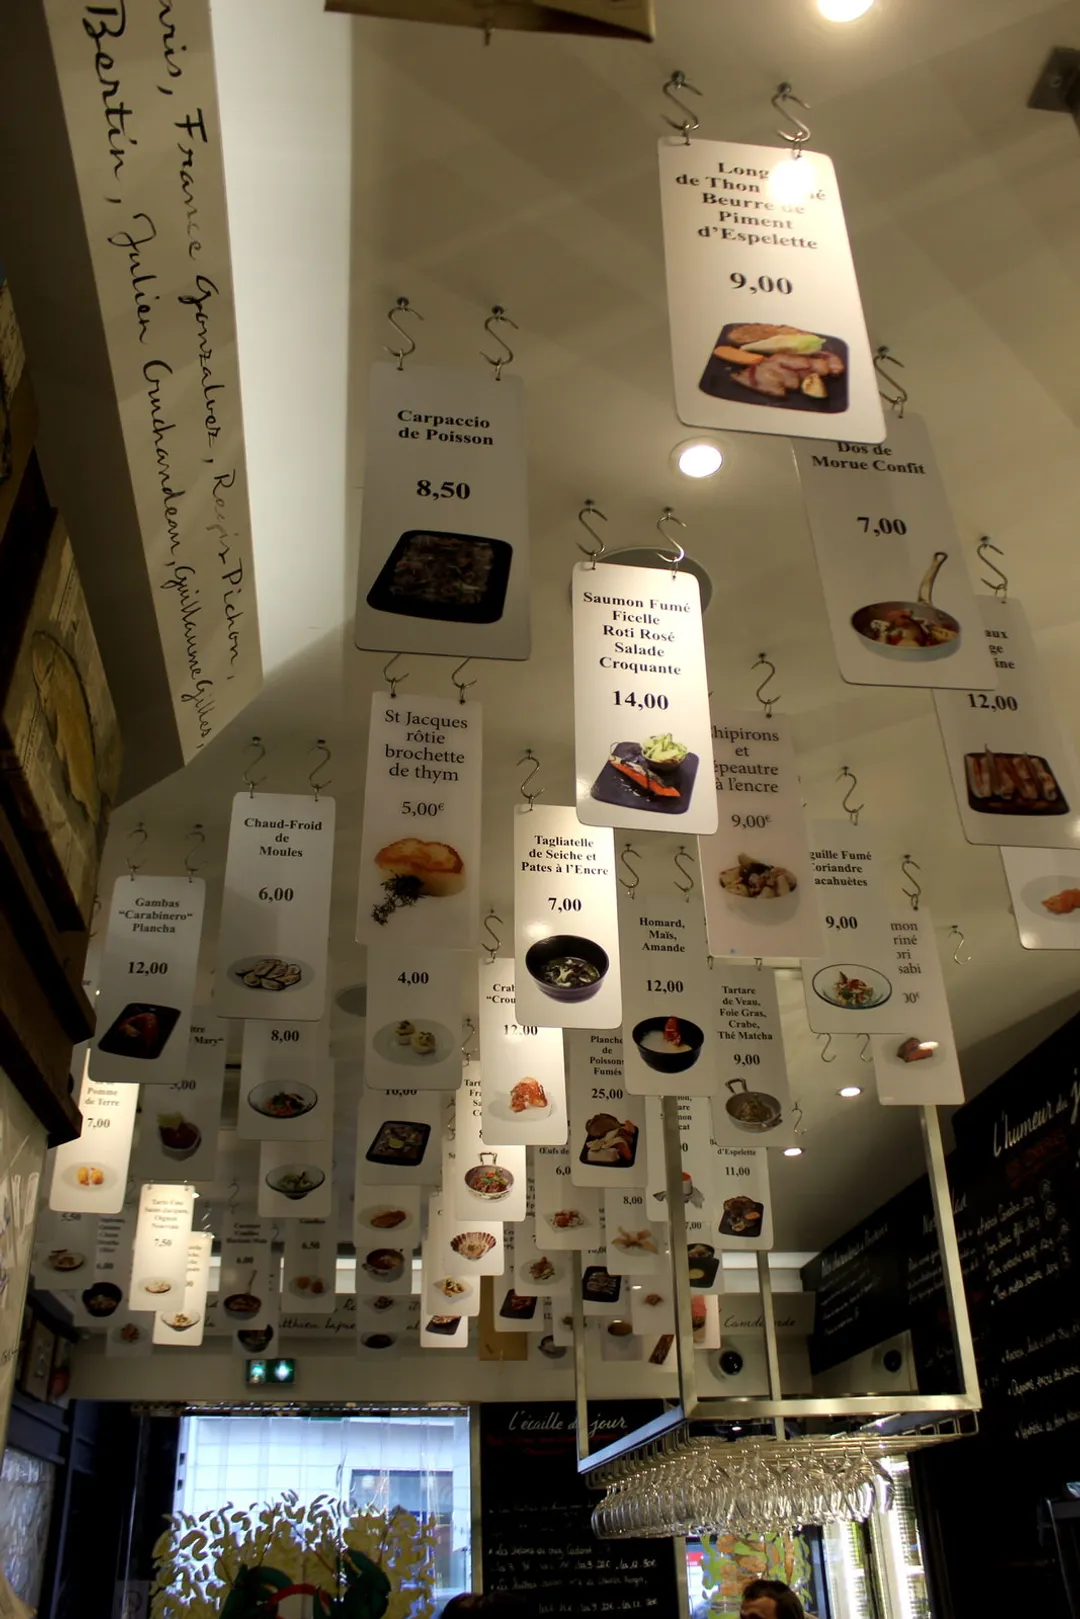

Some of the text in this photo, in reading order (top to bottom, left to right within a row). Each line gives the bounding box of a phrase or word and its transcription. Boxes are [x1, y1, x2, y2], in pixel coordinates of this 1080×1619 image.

[718, 162, 769, 180] Long
[173, 108, 208, 259] France
[675, 174, 761, 193] de Thon
[702, 192, 775, 211] Beurre
[718, 211, 794, 230] Piment
[697, 226, 818, 249] d'Espelette
[730, 272, 793, 295] 9,00
[178, 275, 225, 464] Gonzalvez,
[397, 409, 490, 429] Carpaccio
[398, 427, 494, 446] de Poisson
[837, 441, 893, 456] Dos de
[811, 455, 927, 475] Morue Confit
[108, 213, 157, 344] Julien
[160, 564, 202, 681] Guillaume
[181, 679, 214, 749] Gilles,
[416, 479, 471, 501] 8,50
[856, 516, 907, 537] 7,00
[582, 591, 691, 613] Saumon Fumé
[220, 557, 245, 680] Pichon,
[612, 610, 661, 625] Ficelle
[602, 624, 676, 642] Roti Rosé
[984, 629, 1008, 639] aux
[614, 641, 665, 657] Salade
[988, 644, 1004, 656] ge
[599, 656, 682, 675] Croquante
[993, 657, 1016, 669] ine
[613, 690, 669, 711] 14,00
[967, 693, 1018, 713] 12,00
[384, 709, 468, 731] St Jacques
[406, 729, 446, 744] rôtie
[712, 725, 780, 743] hipirons
[385, 743, 465, 764] brochette
[734, 745, 750, 757] et
[388, 762, 460, 784] de thym
[728, 777, 779, 793] l'encre
[244, 817, 323, 831] Chaud-Froid
[275, 832, 290, 843] de
[534, 834, 594, 847] Tagliatelle
[259, 846, 304, 857] Moules
[529, 848, 597, 861] de Seiche et
[809, 849, 872, 862] guille Fumé
[521, 861, 609, 876] Pates à l'Encre
[814, 876, 869, 887] acahuètes
[258, 886, 294, 903] 6,00
[135, 897, 180, 908] Gambas
[548, 897, 582, 914] 7,00
[132, 923, 176, 933] Plancha
[639, 917, 686, 929] Homard,
[825, 915, 858, 932] 9,00
[890, 921, 918, 931] mon
[648, 930, 678, 941] Maïs,
[641, 942, 686, 953] Amande
[127, 961, 168, 976] 12,00
[898, 962, 922, 974] sabi
[397, 971, 430, 987] 4,00
[646, 979, 684, 994] 12,00
[721, 985, 756, 995] Tartare
[486, 995, 516, 1004] "Crou
[722, 997, 761, 1007] de Veau,
[719, 1008, 767, 1018] Foie Gras,
[728, 1019, 760, 1029] Crabe,
[270, 1029, 300, 1043] 8,00
[717, 1030, 773, 1041] Thé Matcha
[602, 1046, 613, 1054] de
[733, 1053, 761, 1067] 9,00
[593, 1066, 622, 1076] Fumés
[87, 1087, 118, 1096] Pomme
[591, 1088, 623, 1100] 25,00
[98, 1098, 120, 1107] Terre
[87, 1117, 111, 1129] 7,00
[555, 1165, 571, 1176] 6,0
[725, 1166, 751, 1177] 11,00
[623, 1195, 643, 1206] 8,00
[154, 1238, 173, 1248] 7,50
